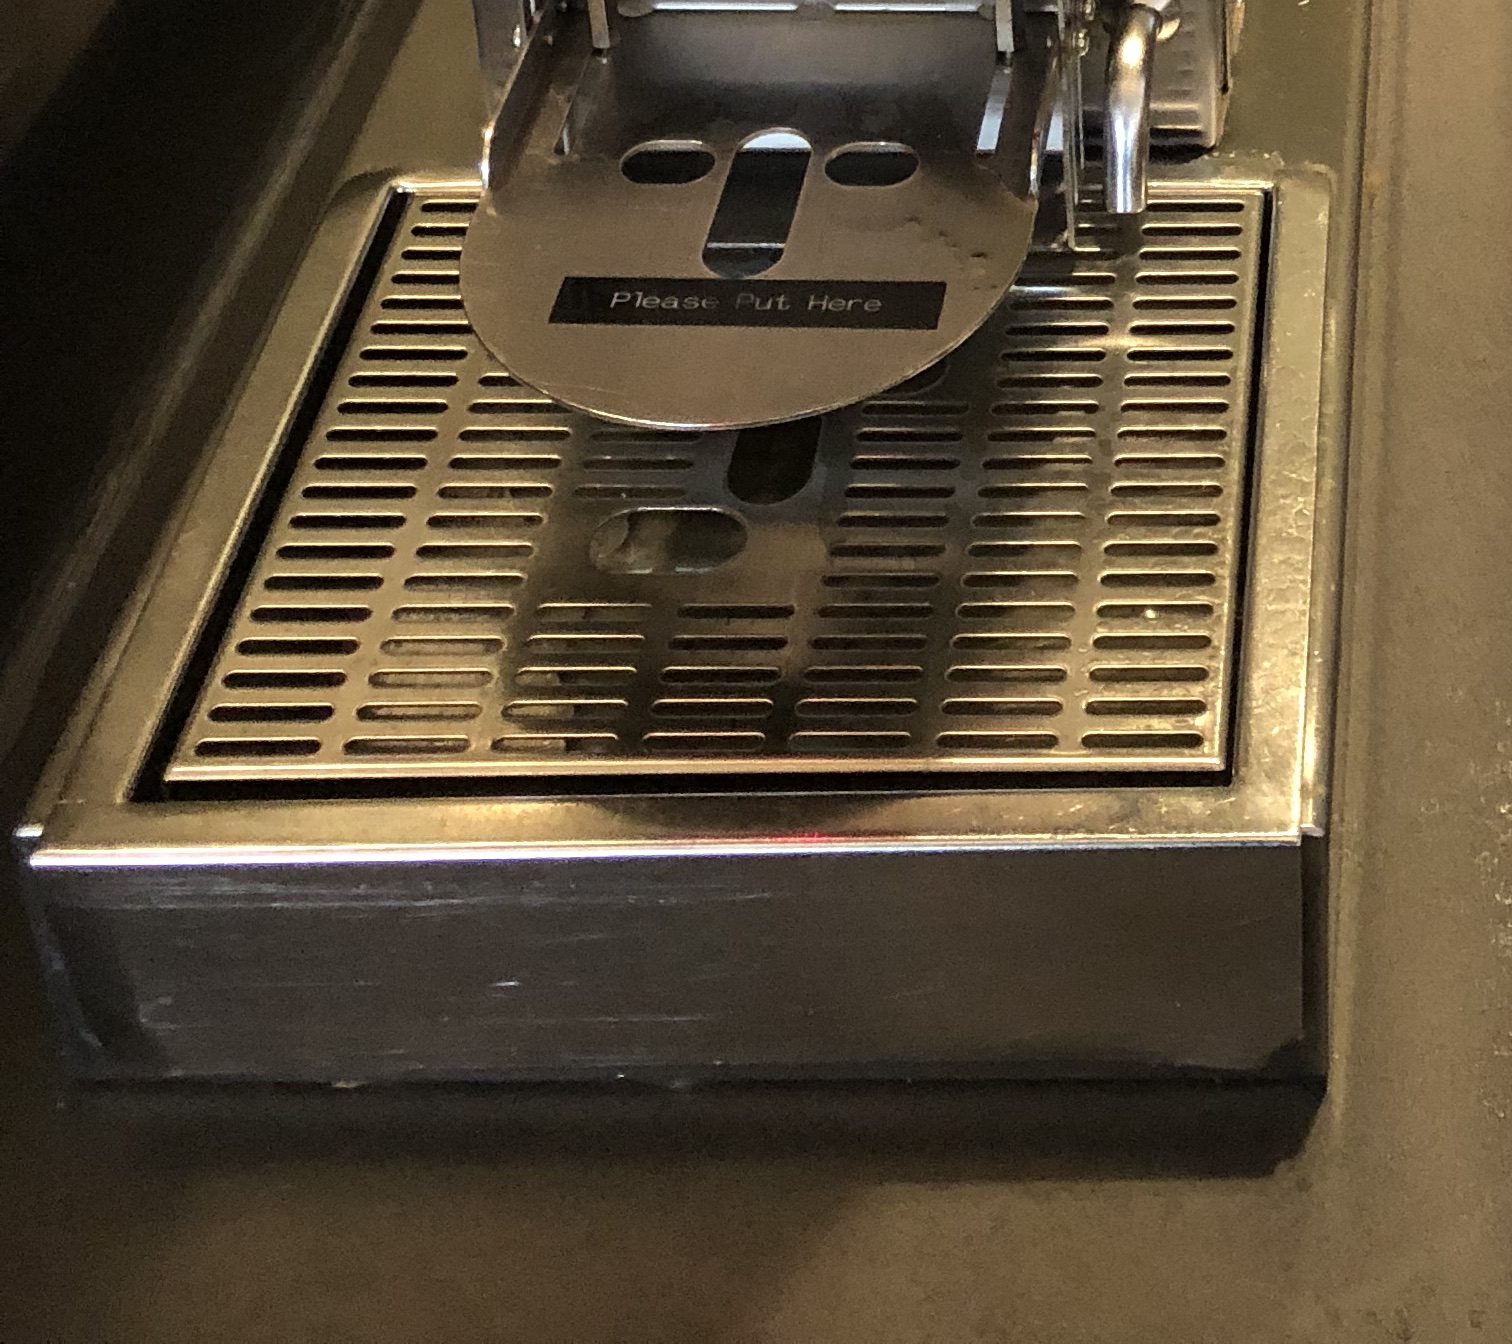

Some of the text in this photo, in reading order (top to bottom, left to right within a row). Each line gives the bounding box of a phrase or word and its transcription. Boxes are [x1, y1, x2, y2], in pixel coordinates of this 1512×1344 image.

[610, 290, 883, 314] Please Put Here
